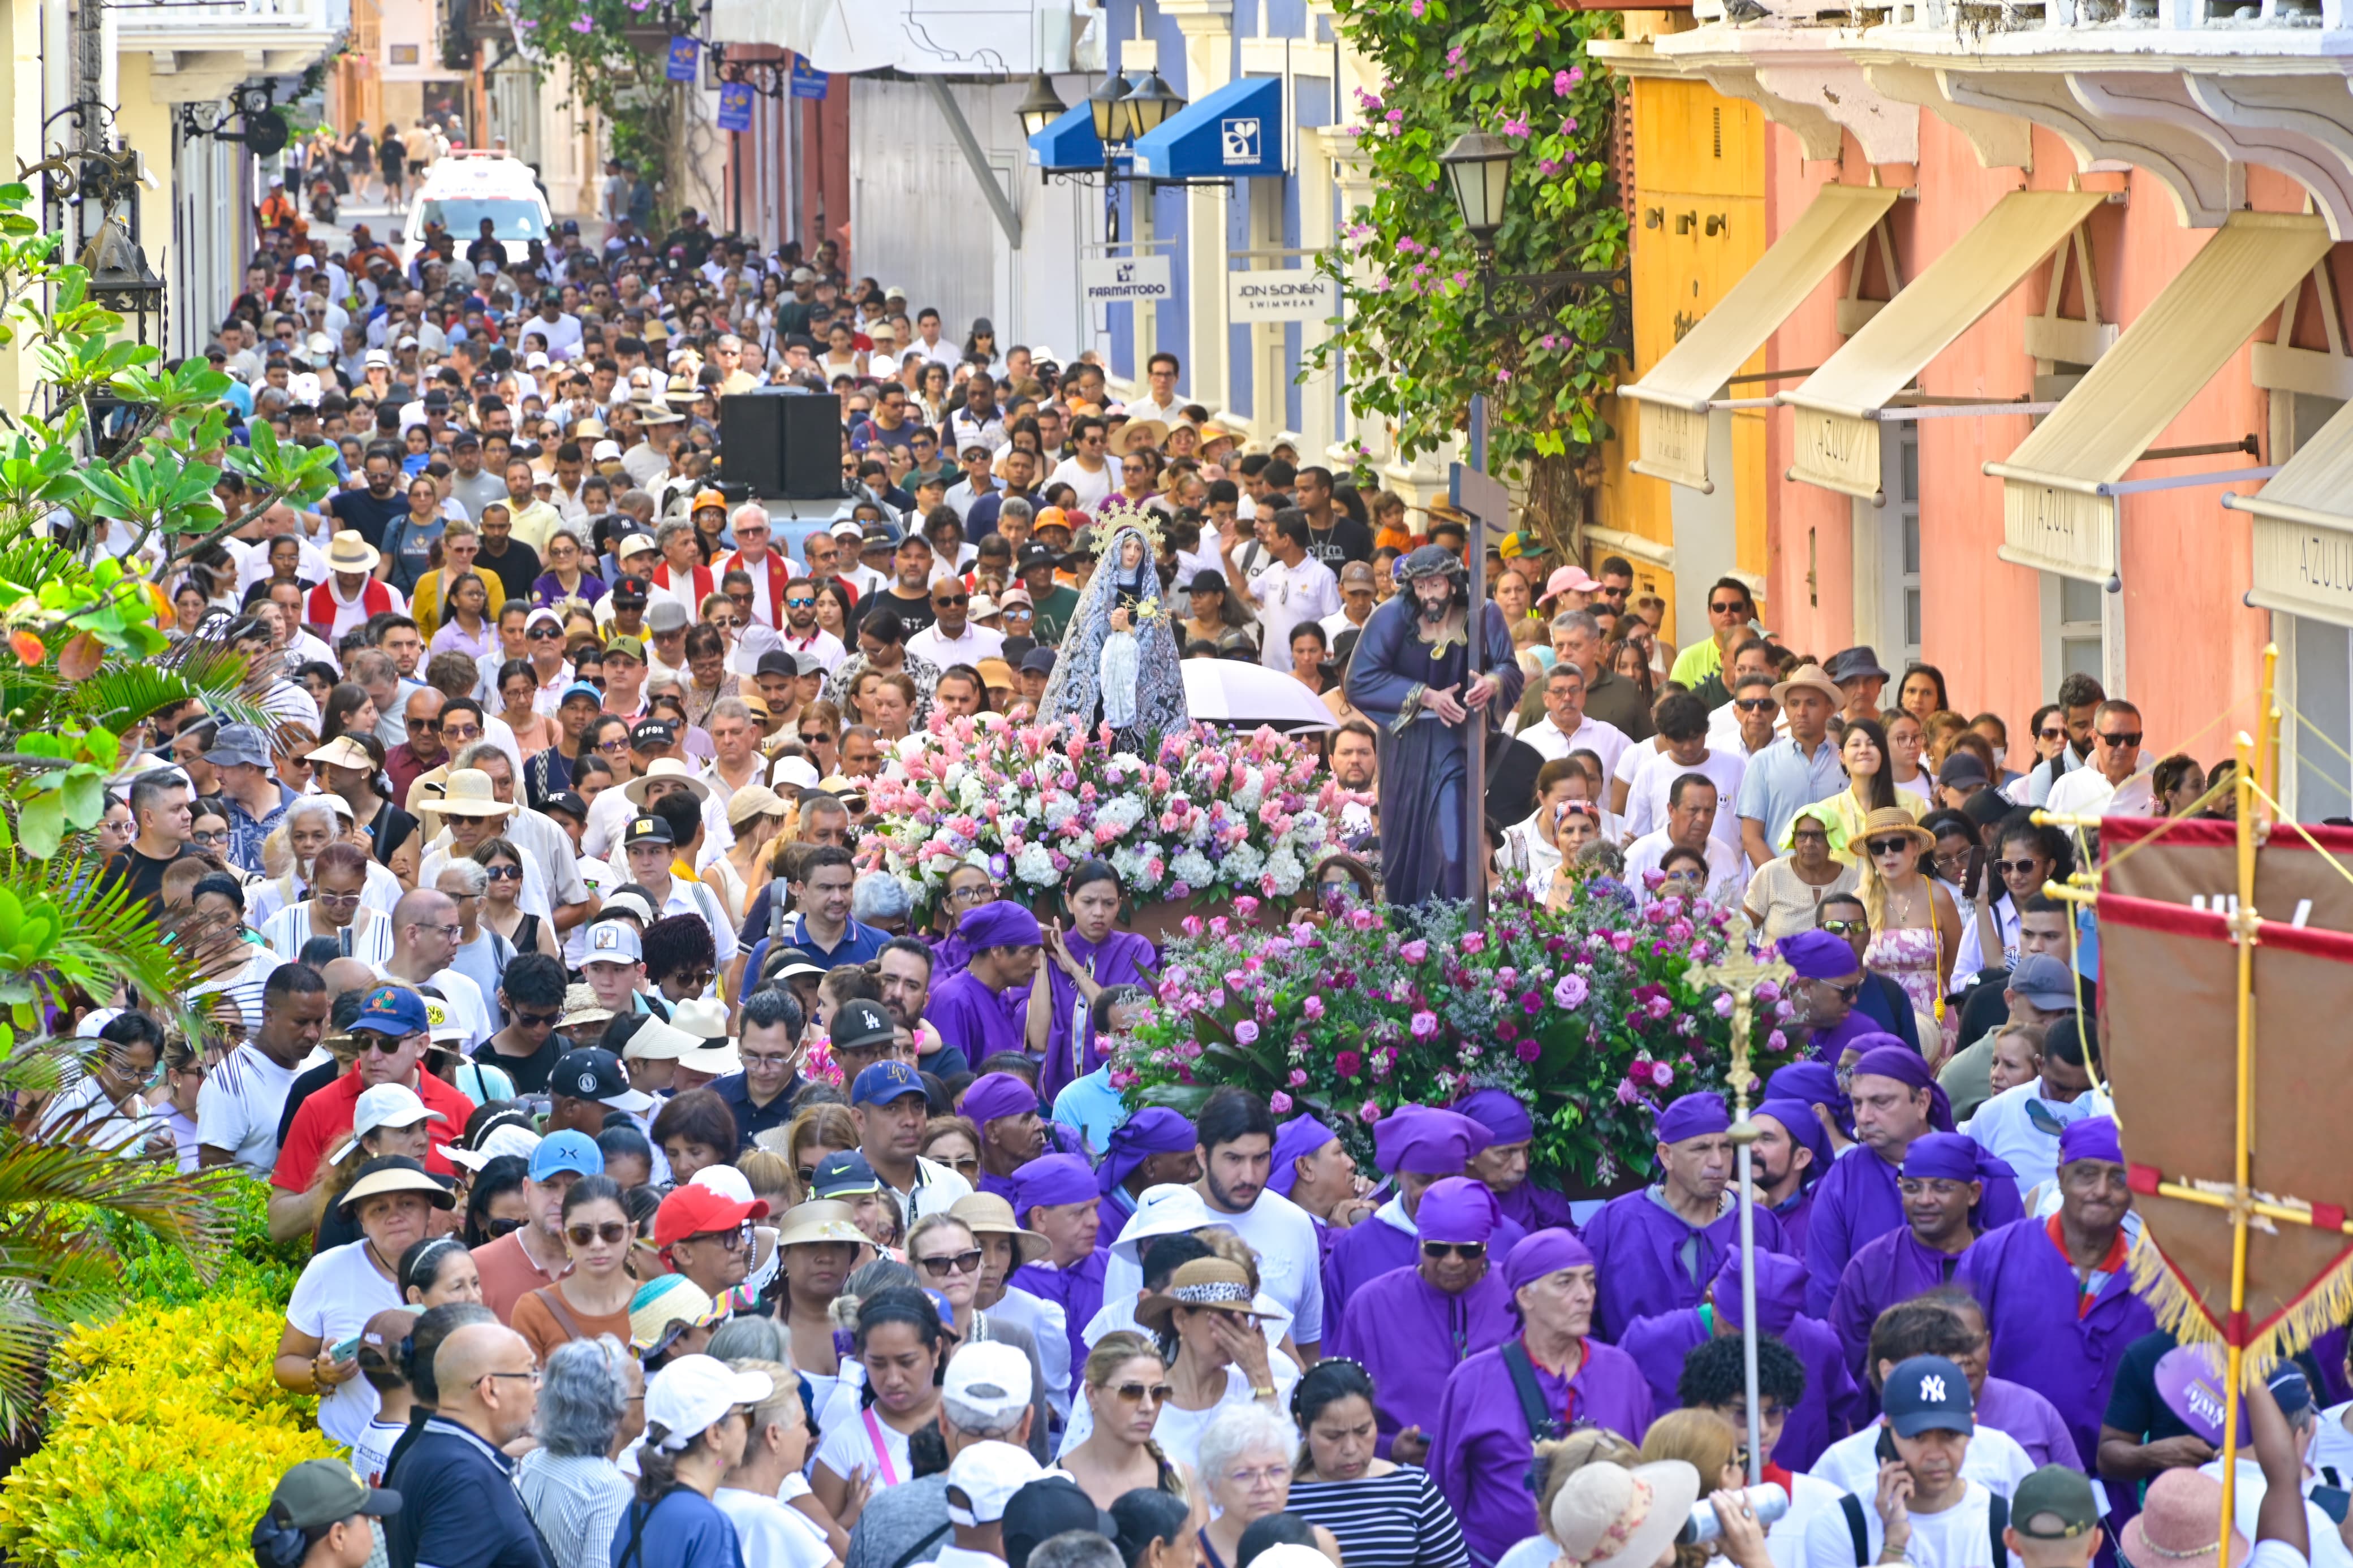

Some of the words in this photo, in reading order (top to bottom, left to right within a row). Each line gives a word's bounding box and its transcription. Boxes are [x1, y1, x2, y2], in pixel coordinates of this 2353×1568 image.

[1088, 283, 1166, 298] FARMATODO
[1239, 284, 1267, 297] JON
[1269, 283, 1324, 296] SONEN
[1249, 299, 1315, 309] SWIMWEAR
[2037, 488, 2076, 536] AZULU
[2300, 536, 2353, 591] AZULU
[645, 725, 664, 735] FOX
[862, 1008, 881, 1030] LA
[887, 1063, 910, 1085] LV
[1920, 1373, 1946, 1402] NY
